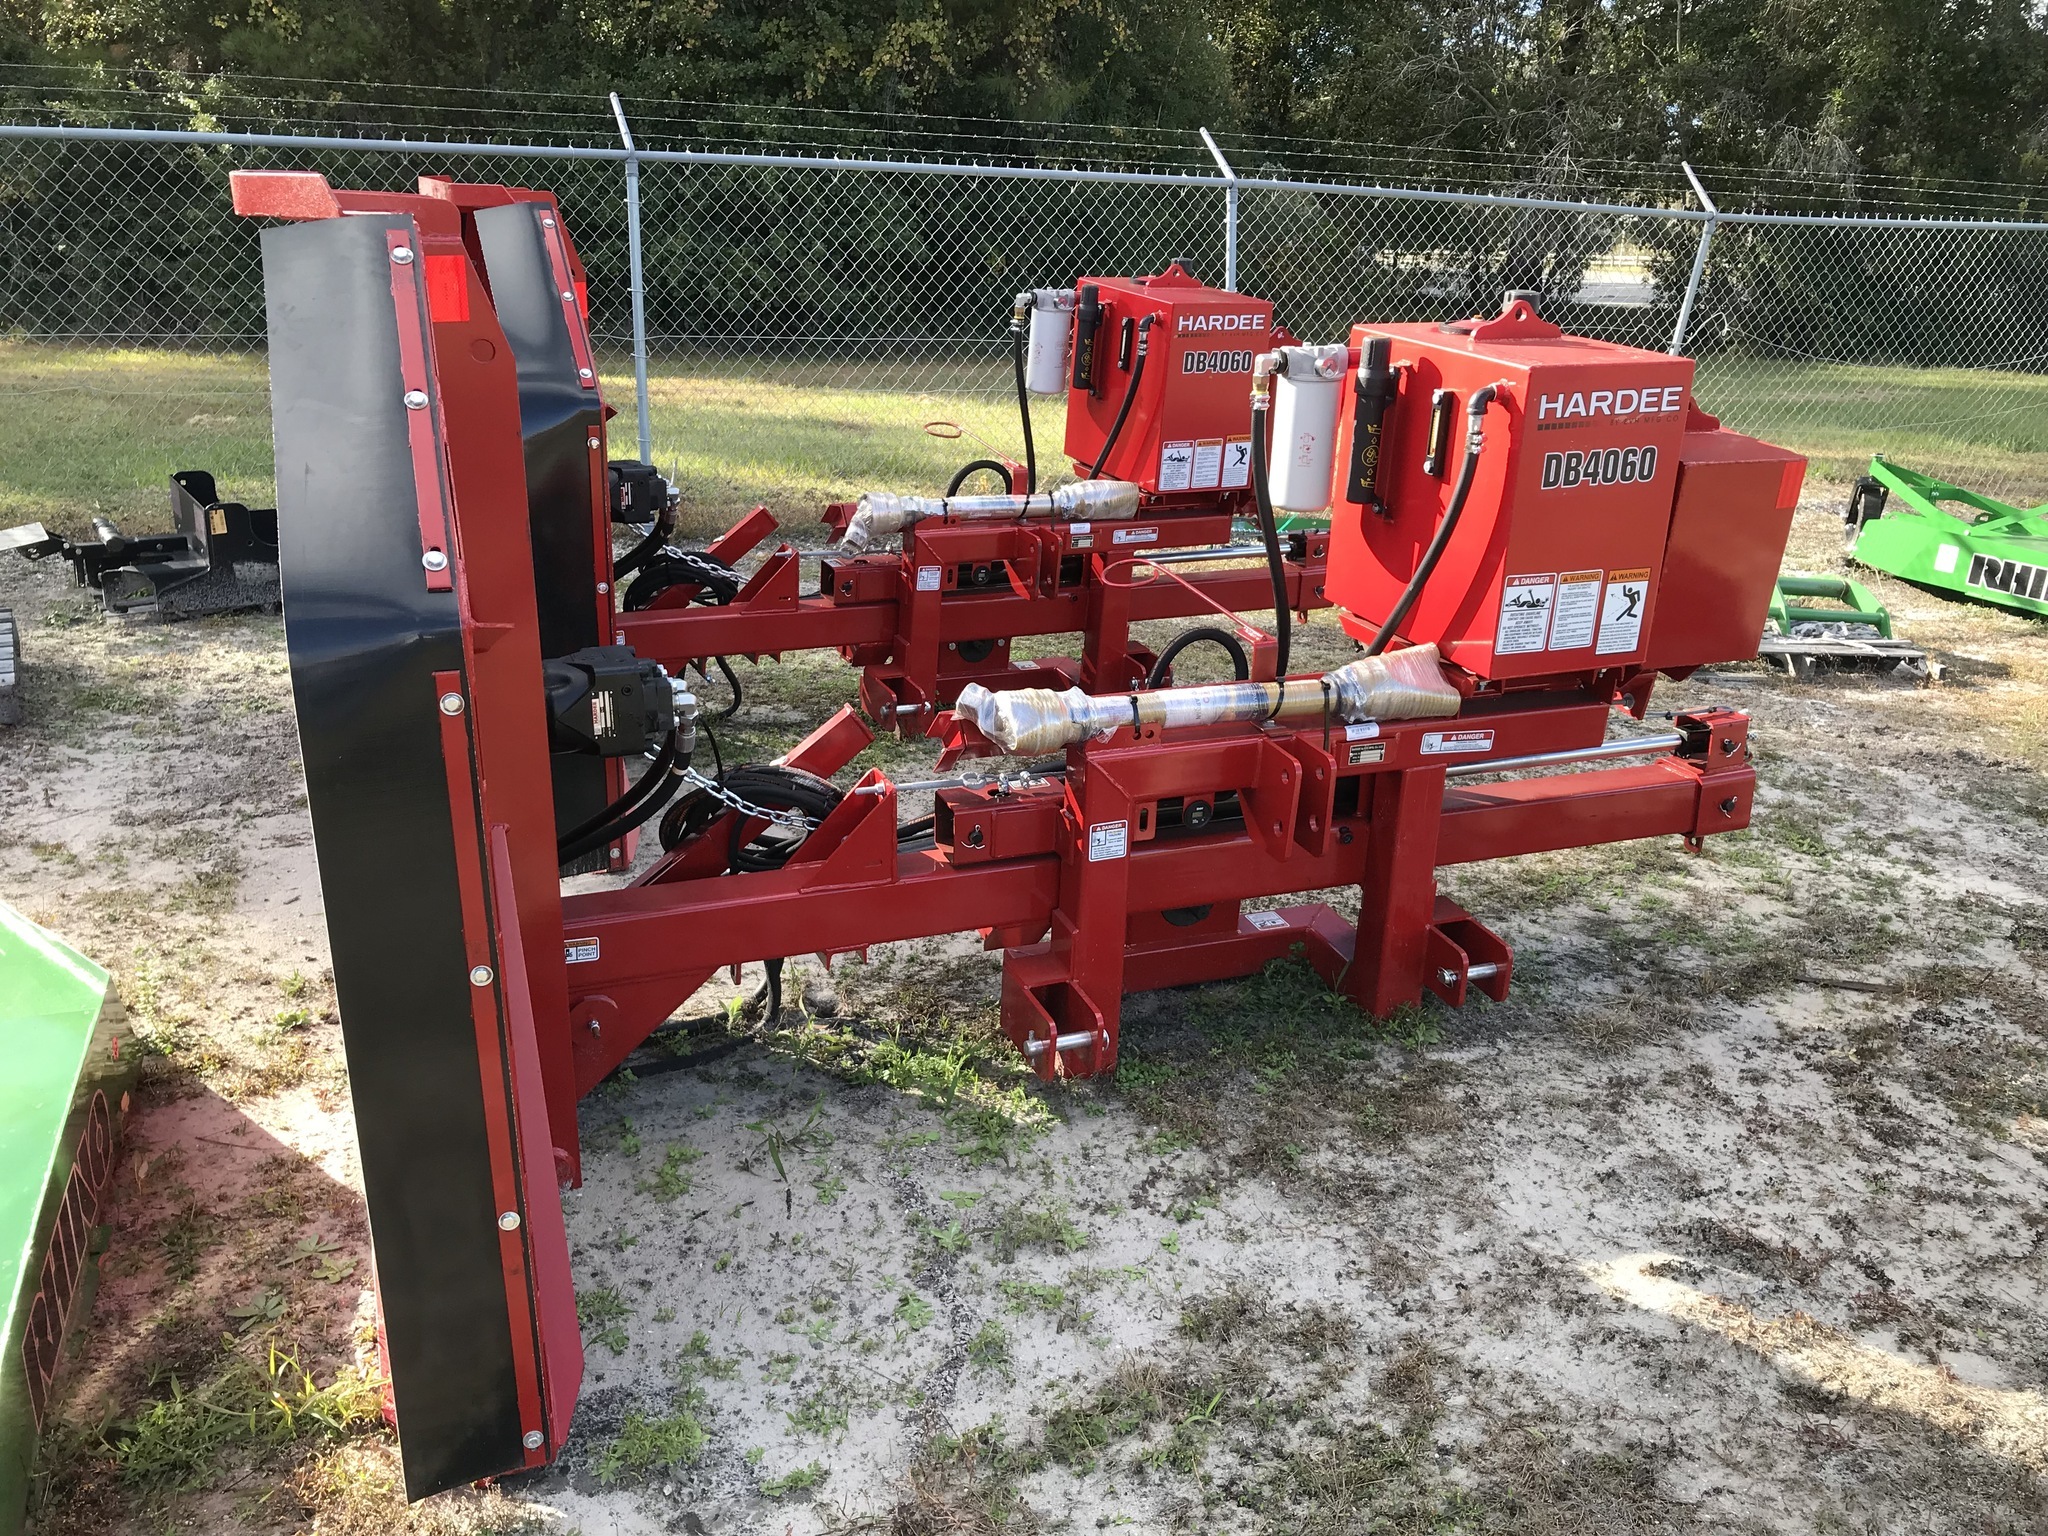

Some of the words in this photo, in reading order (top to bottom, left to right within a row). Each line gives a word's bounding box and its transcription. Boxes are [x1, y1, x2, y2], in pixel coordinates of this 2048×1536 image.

[1177, 313, 1266, 332] HARDEE
[1182, 350, 1252, 373] DB4060
[1538, 386, 1684, 420] HARDEE
[1541, 445, 1658, 490] DB4060
[1520, 576, 1550, 585] DANGER
[1569, 572, 1600, 582] WARNING
[1618, 571, 1649, 580] WARNING
[1966, 553, 2048, 603] RHI
[22, 1088, 113, 1433] RHINO
